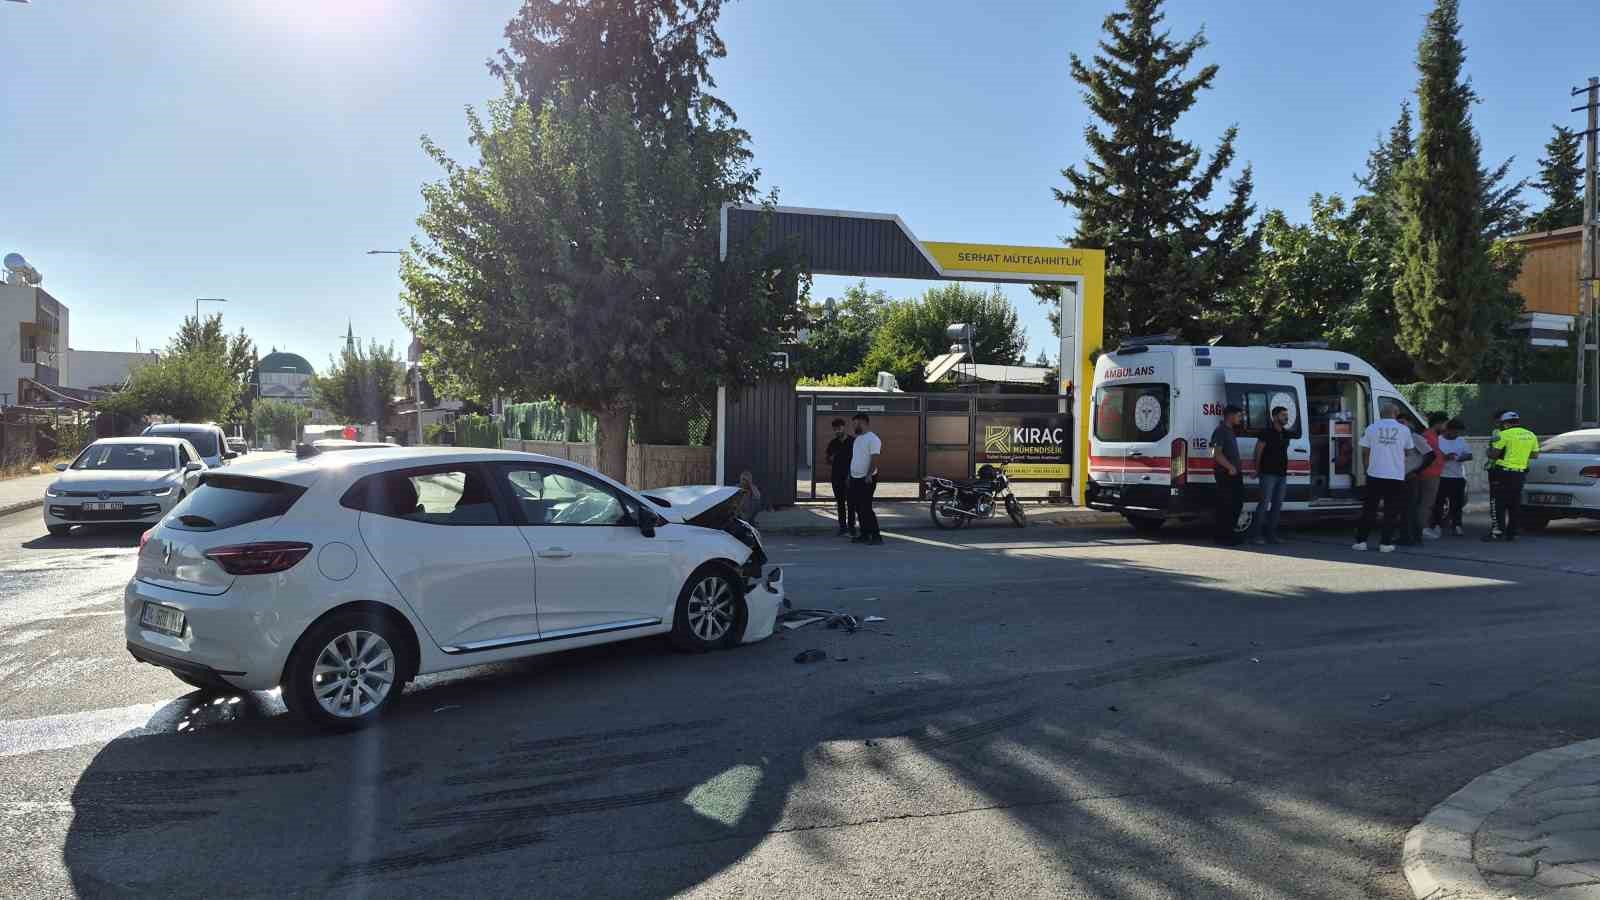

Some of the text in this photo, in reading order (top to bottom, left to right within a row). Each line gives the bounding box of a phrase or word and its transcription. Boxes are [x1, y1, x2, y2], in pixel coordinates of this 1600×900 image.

[957, 252, 1001, 264] SERHAT
[1104, 366, 1155, 380] AMBULANS
[1013, 426, 1064, 445] KIRAÇ
[1378, 427, 1399, 440] 112
[1192, 438, 1208, 449] 112
